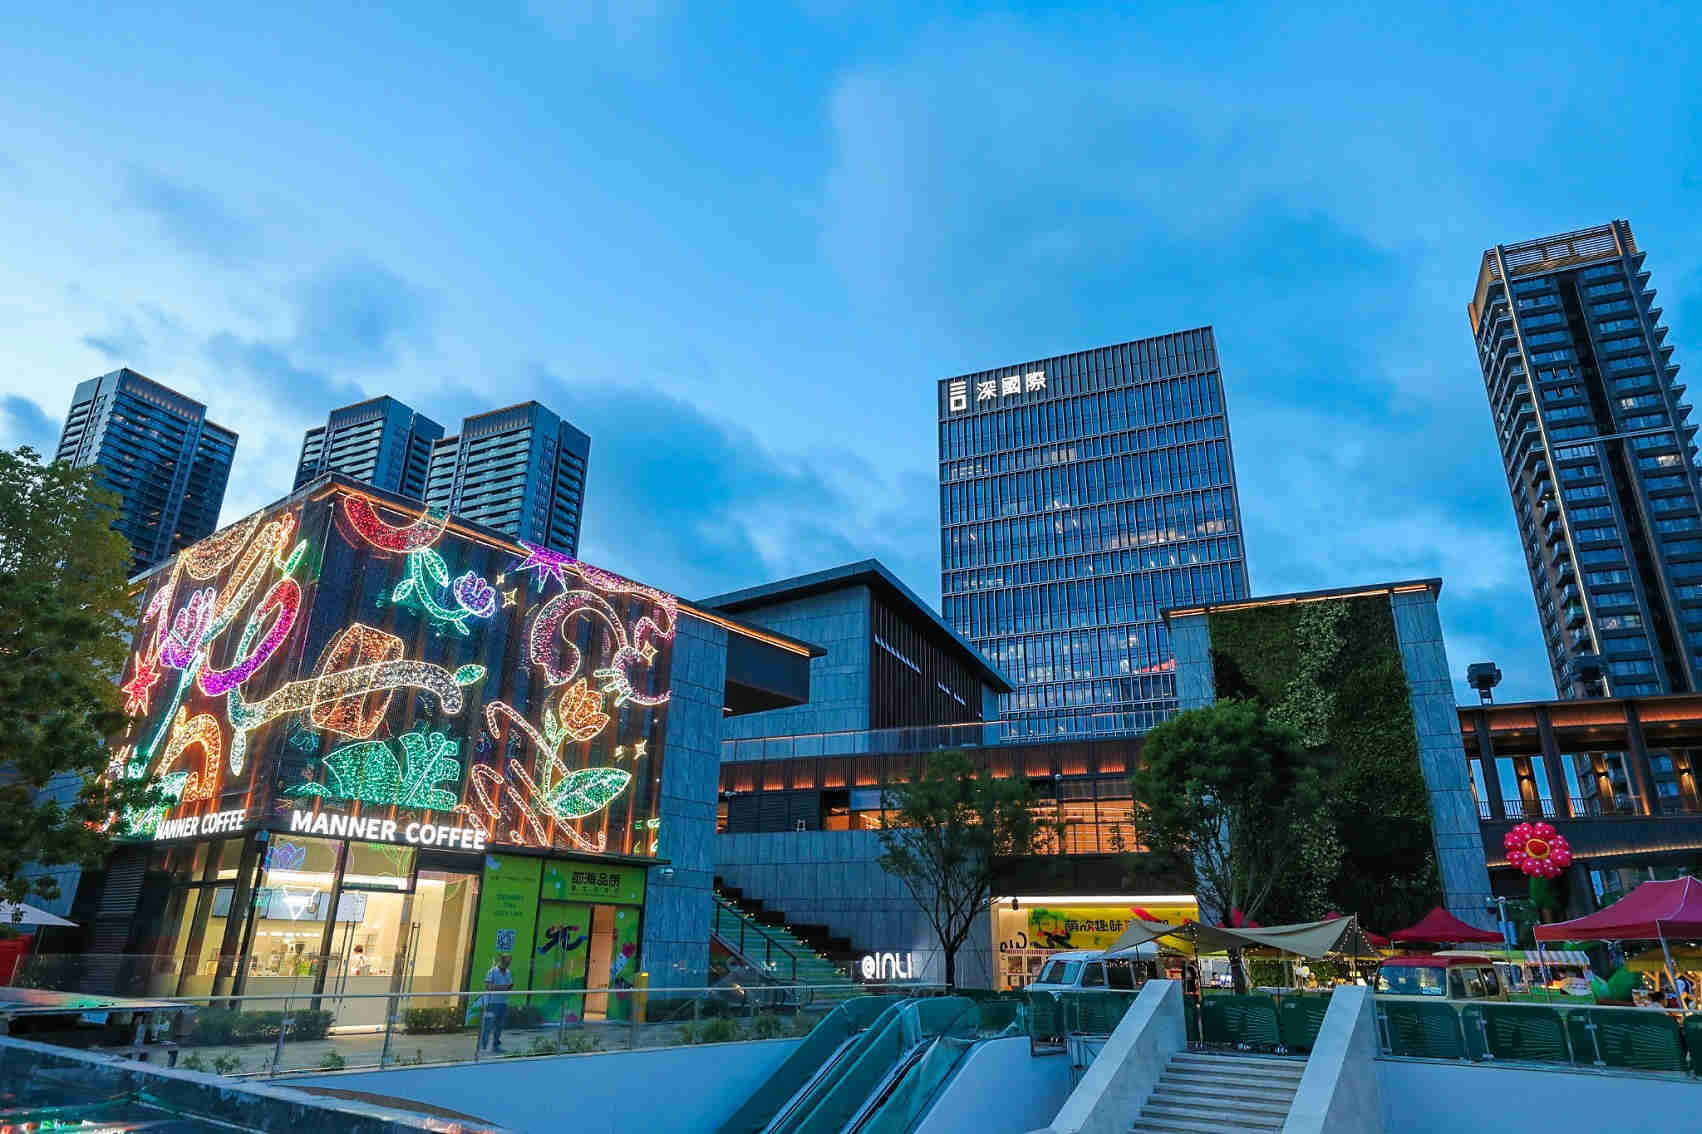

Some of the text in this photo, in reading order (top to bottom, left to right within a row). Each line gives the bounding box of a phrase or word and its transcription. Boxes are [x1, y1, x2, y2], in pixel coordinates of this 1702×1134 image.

[976, 371, 1047, 401] 深國際
[154, 809, 249, 841] MANNER COFFEE
[291, 809, 487, 850] MANNER COFFEE
